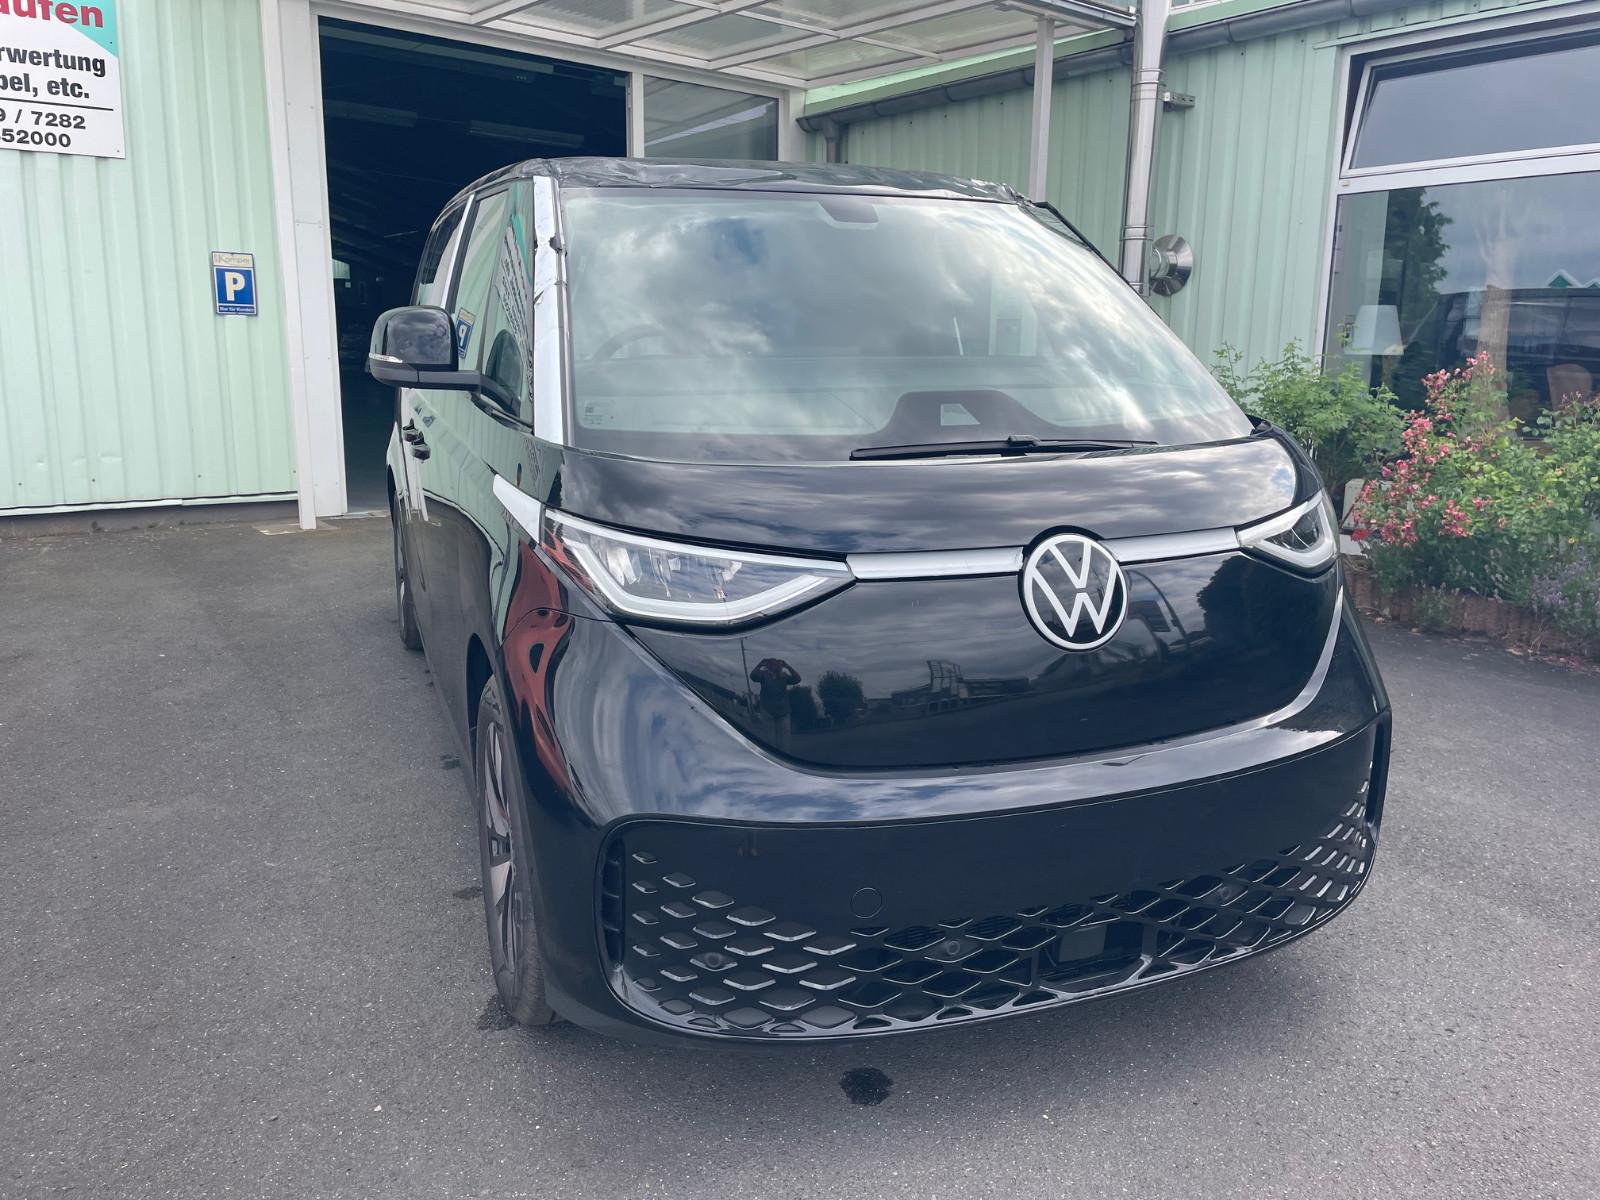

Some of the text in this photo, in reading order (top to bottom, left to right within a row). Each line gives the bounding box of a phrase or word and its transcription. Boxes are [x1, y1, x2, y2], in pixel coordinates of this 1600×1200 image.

[47, 77, 90, 99] etc.
[31, 110, 86, 130] 7282
[0, 128, 72, 148] 52000
[224, 271, 246, 302] P
[1027, 537, 1119, 639] VW
